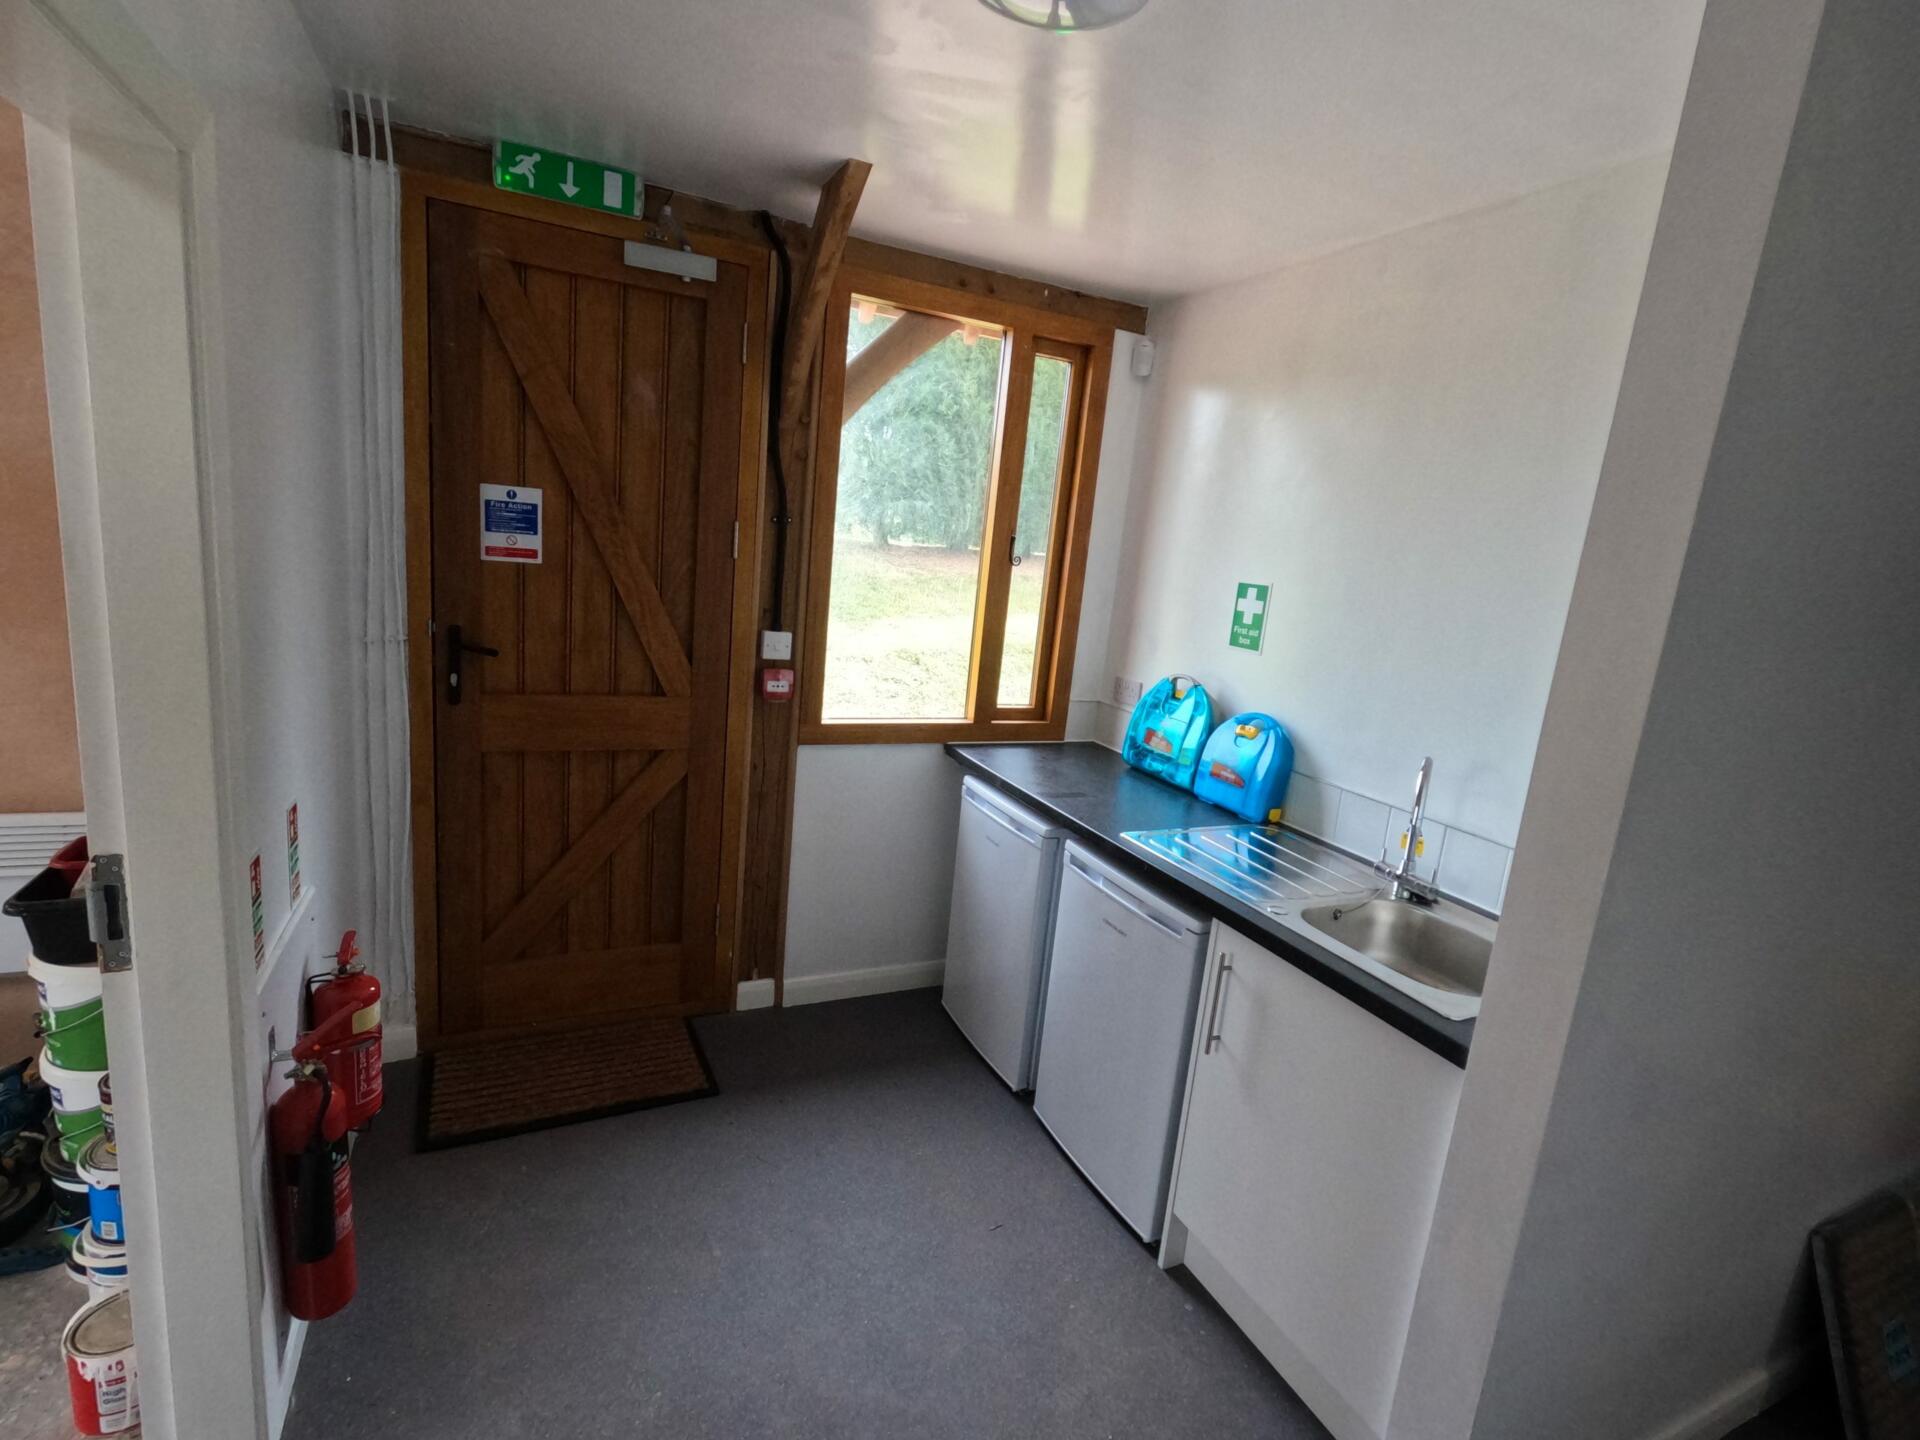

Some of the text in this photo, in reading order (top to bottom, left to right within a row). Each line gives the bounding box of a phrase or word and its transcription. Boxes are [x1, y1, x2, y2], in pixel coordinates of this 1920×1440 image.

[490, 500, 532, 510] Fire Action
[1234, 625, 1259, 637] First aid
[1238, 636, 1250, 645] box
